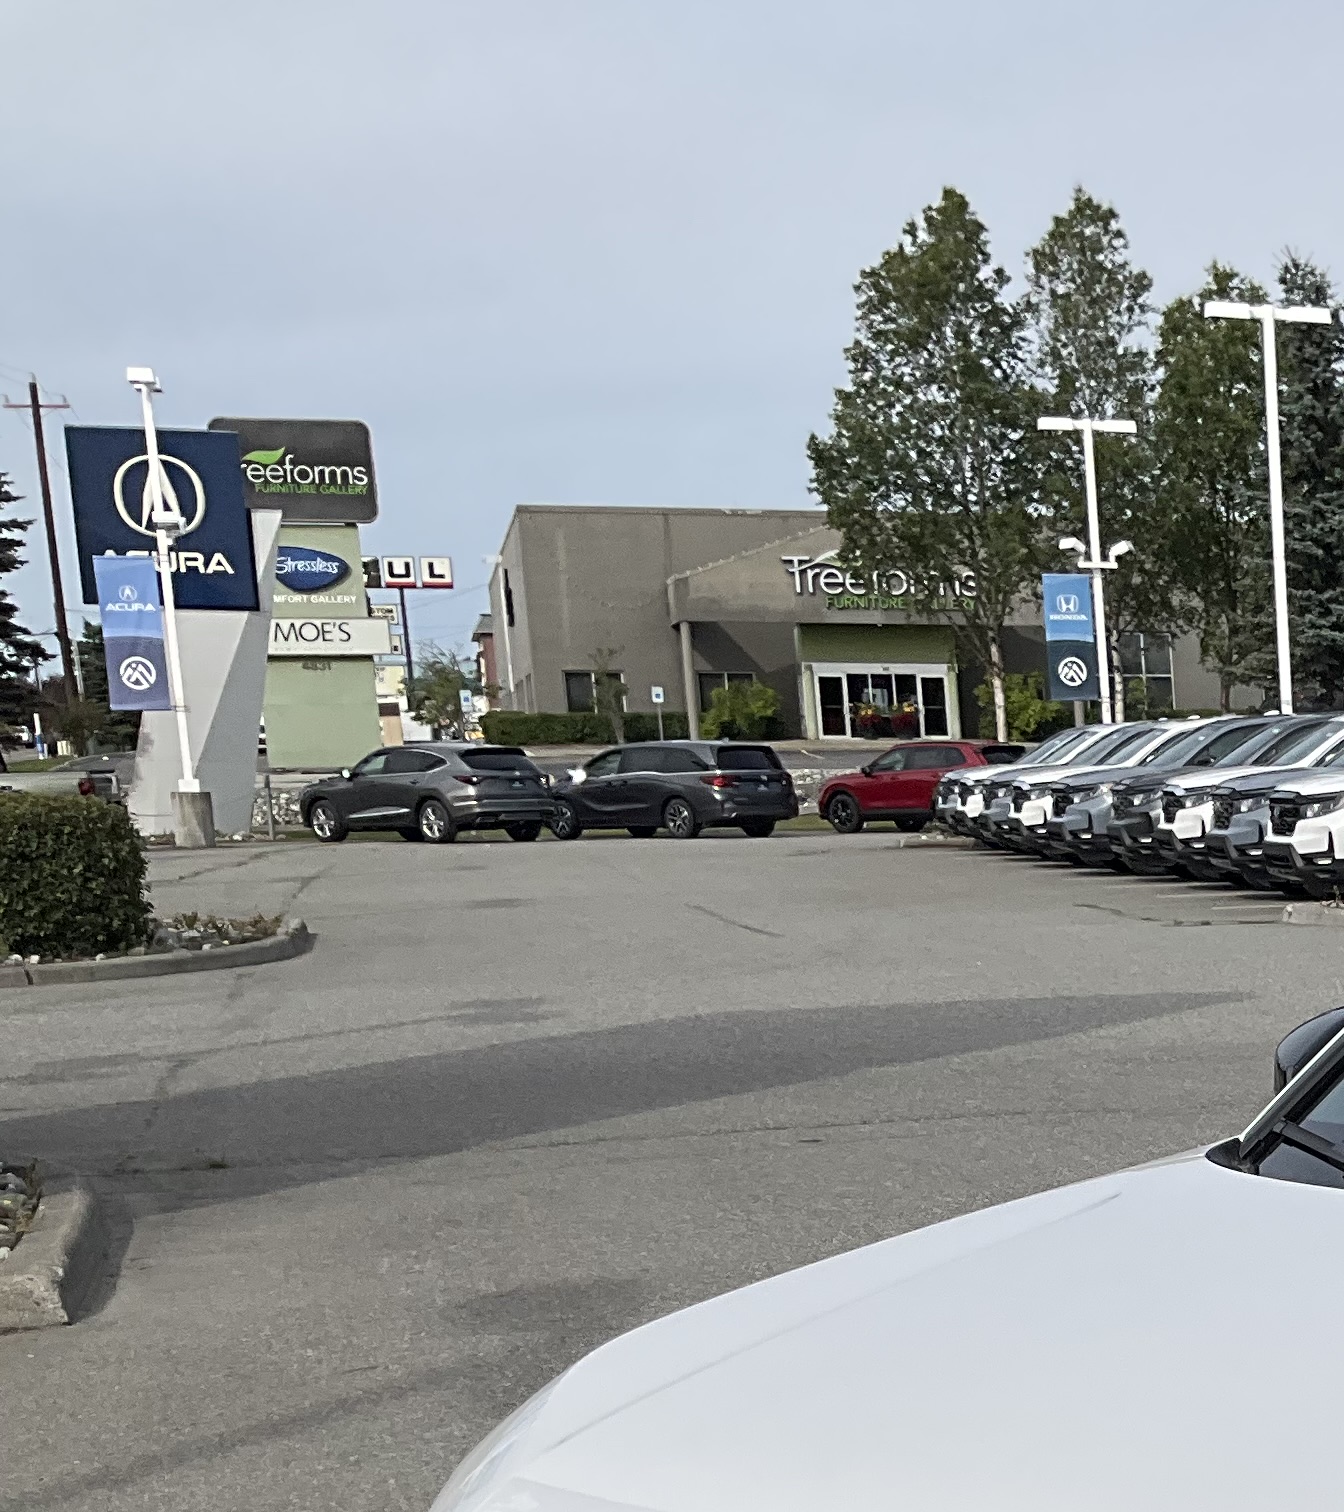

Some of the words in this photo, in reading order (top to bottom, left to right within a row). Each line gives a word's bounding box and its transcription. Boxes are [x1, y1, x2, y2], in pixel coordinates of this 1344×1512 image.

[241, 454, 369, 486] eeforms
[255, 484, 317, 494] FURNITURE
[320, 486, 368, 495] GALLERY
[103, 549, 235, 574] URA
[275, 557, 340, 574] Stressless
[310, 595, 357, 604] GALLERY
[826, 597, 906, 609] FURNITURE
[105, 603, 156, 612] ACURA
[273, 621, 352, 642] MOE'S
